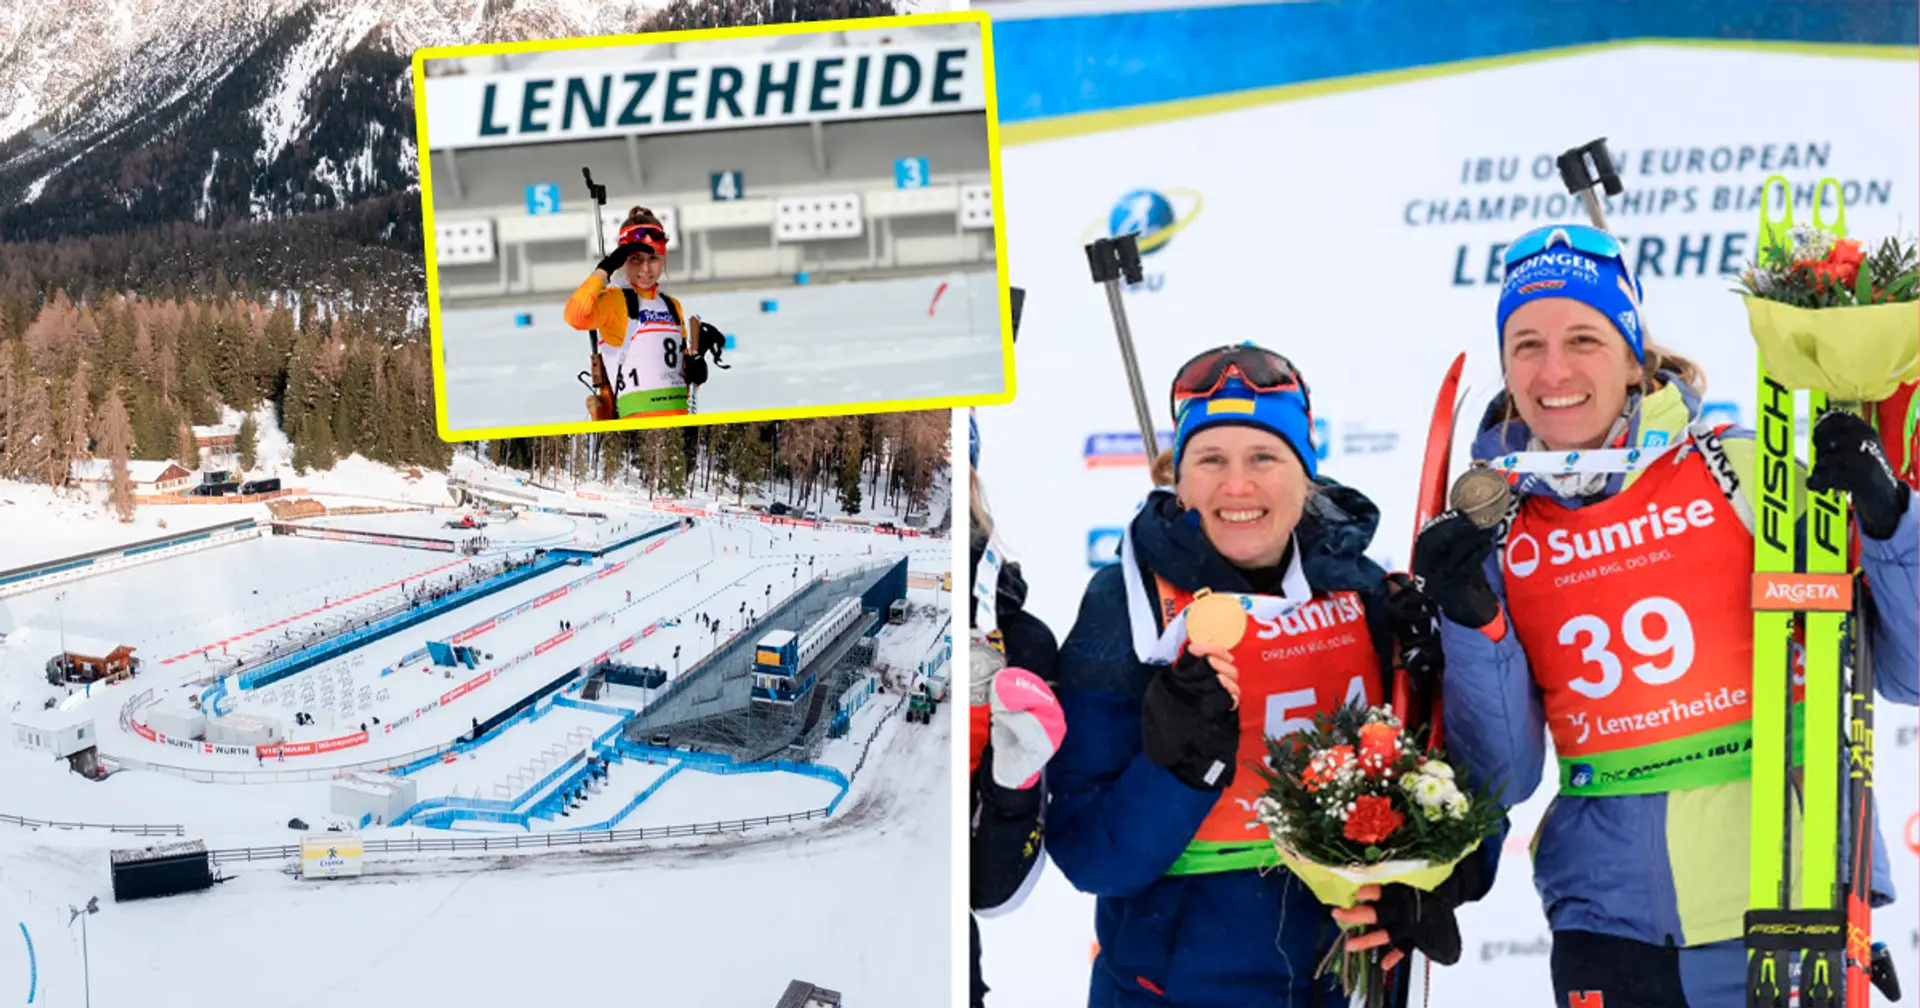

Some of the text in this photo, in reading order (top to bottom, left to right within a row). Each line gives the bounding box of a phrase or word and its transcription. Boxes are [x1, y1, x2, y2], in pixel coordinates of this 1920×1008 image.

[478, 48, 968, 137] LENZERHEIDE
[903, 159, 921, 188] 3
[1461, 141, 1831, 184] IBU ON EUROPEAN
[533, 186, 551, 214] 5
[716, 171, 736, 199] 4
[662, 337, 684, 368] 8
[1762, 375, 1789, 554] FISCH
[1547, 499, 1715, 566] Sunrise
[1554, 568, 1598, 588] DREAM
[1625, 555, 1648, 570] DO
[1764, 580, 1840, 603] ARGETA
[1557, 595, 1696, 699] 39
[1596, 687, 1747, 736] Lenzerheide
[1707, 742, 1740, 758] IBU
[1748, 923, 1842, 935] FISCHER
